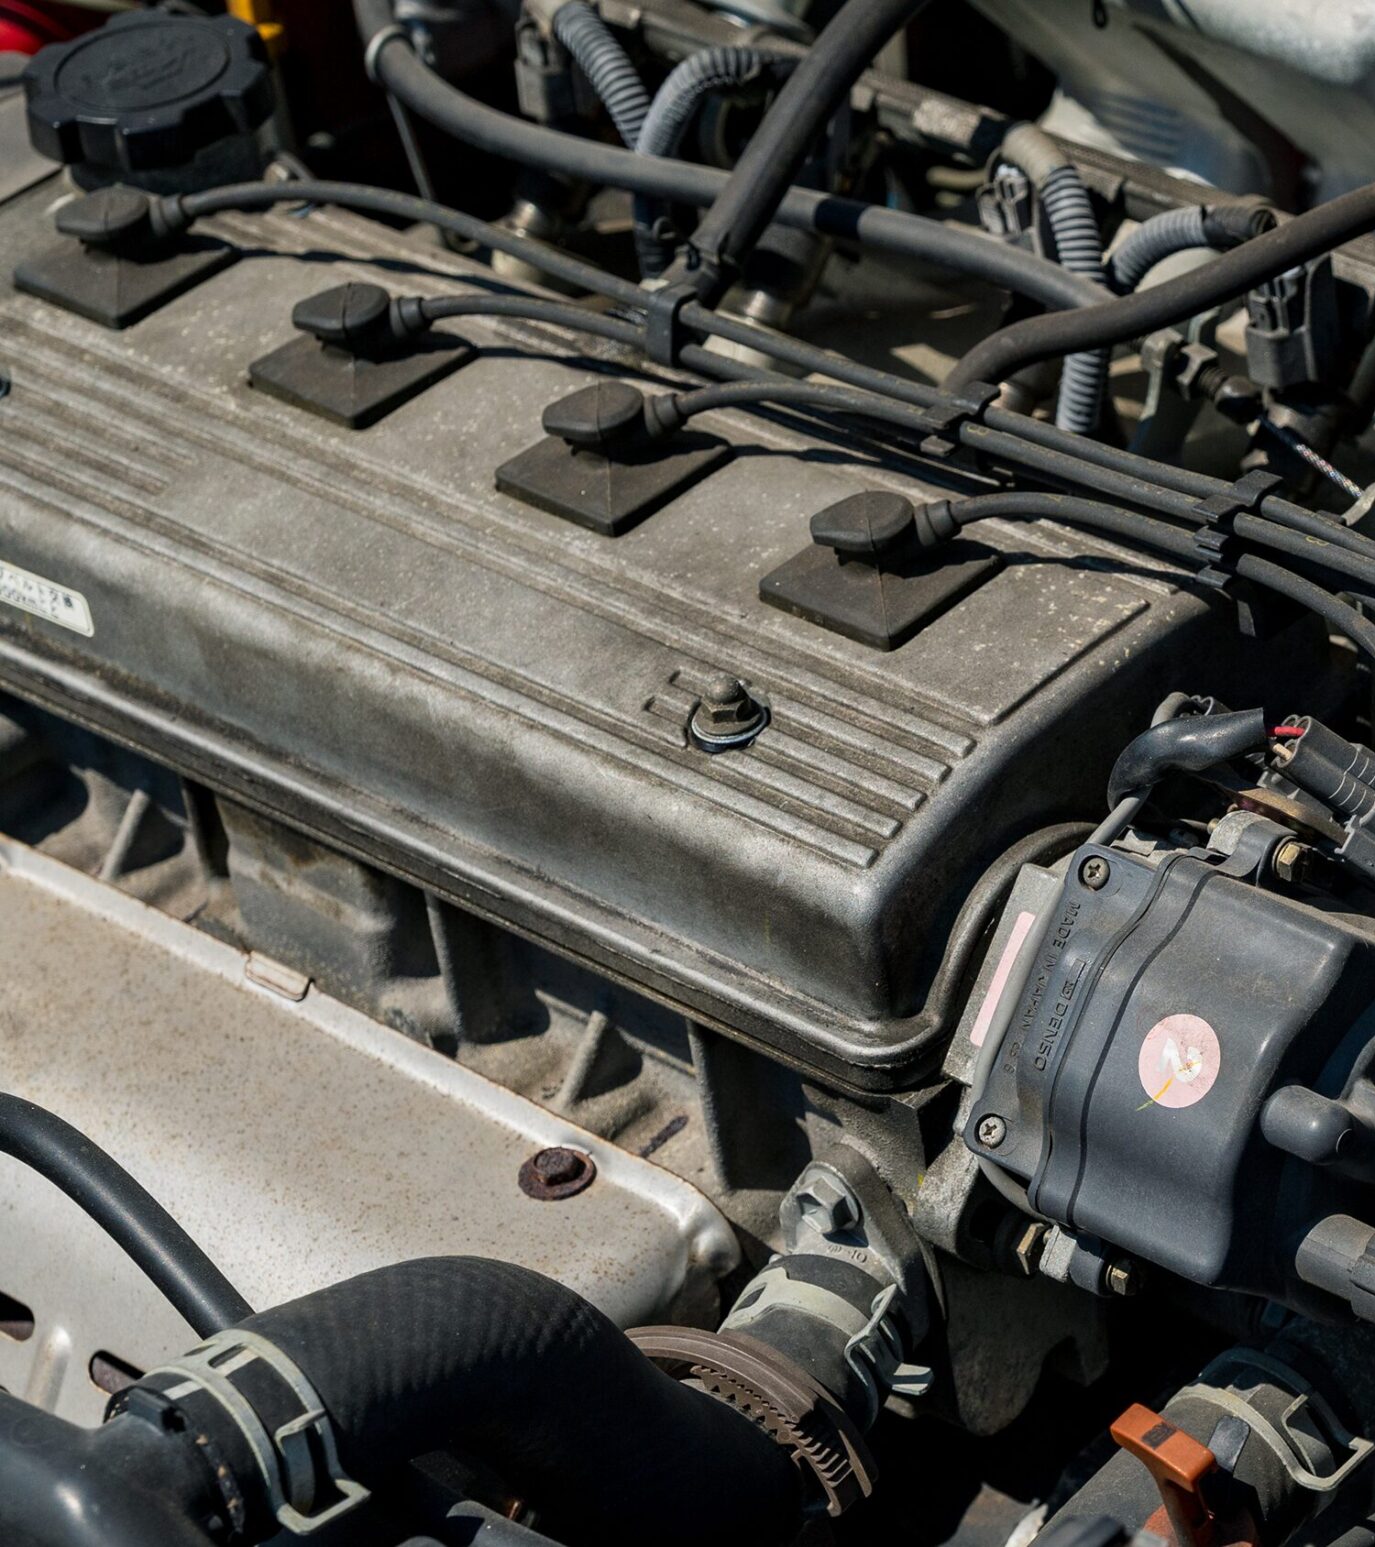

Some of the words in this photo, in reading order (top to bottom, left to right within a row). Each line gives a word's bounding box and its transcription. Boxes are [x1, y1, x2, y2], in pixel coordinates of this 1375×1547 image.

[1053, 902, 1081, 950] MADE
[1044, 954, 1057, 971] IN
[1021, 975, 1048, 1031] JAPAN
[1034, 1003, 1069, 1072] DENSO
